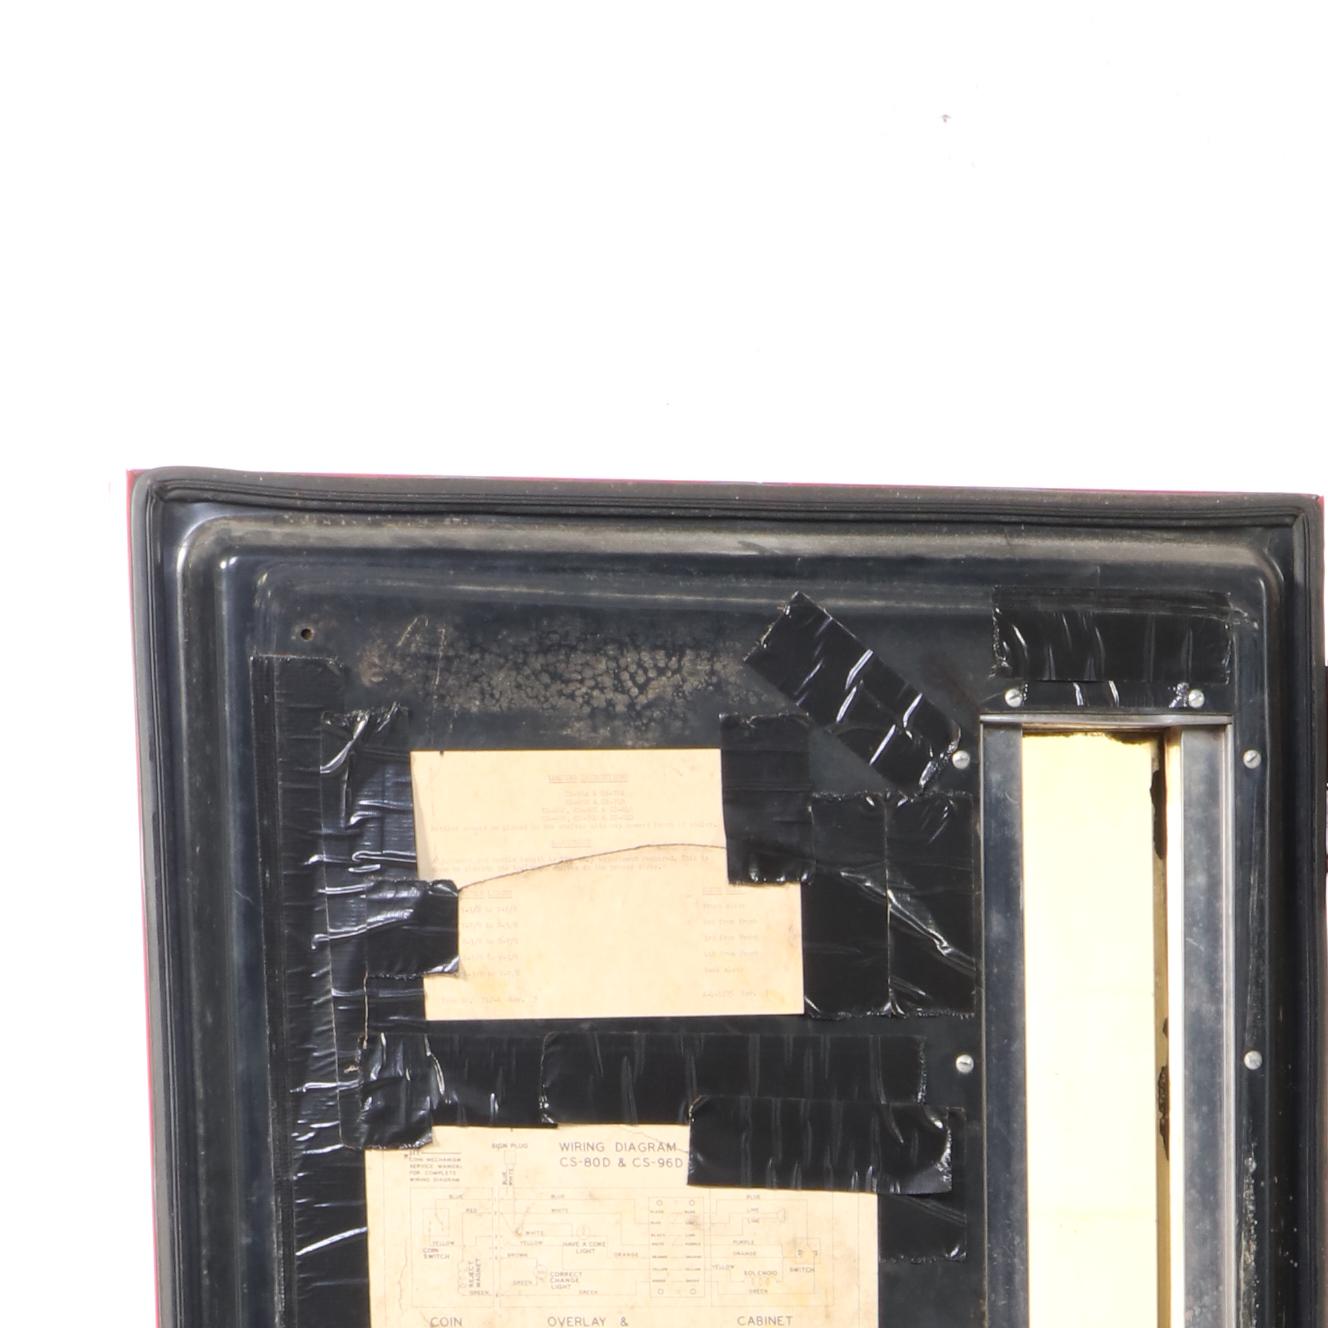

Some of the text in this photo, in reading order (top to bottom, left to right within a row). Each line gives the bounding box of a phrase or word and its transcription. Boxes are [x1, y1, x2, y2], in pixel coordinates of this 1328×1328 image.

[559, 1142, 676, 1153] WIRING DIAGRAM
[559, 1157, 683, 1168] CS-80D & CS-96D
[430, 1316, 463, 1327] COIN
[547, 1316, 629, 1327] OVERLAY &
[736, 1315, 793, 1327] CABINET
